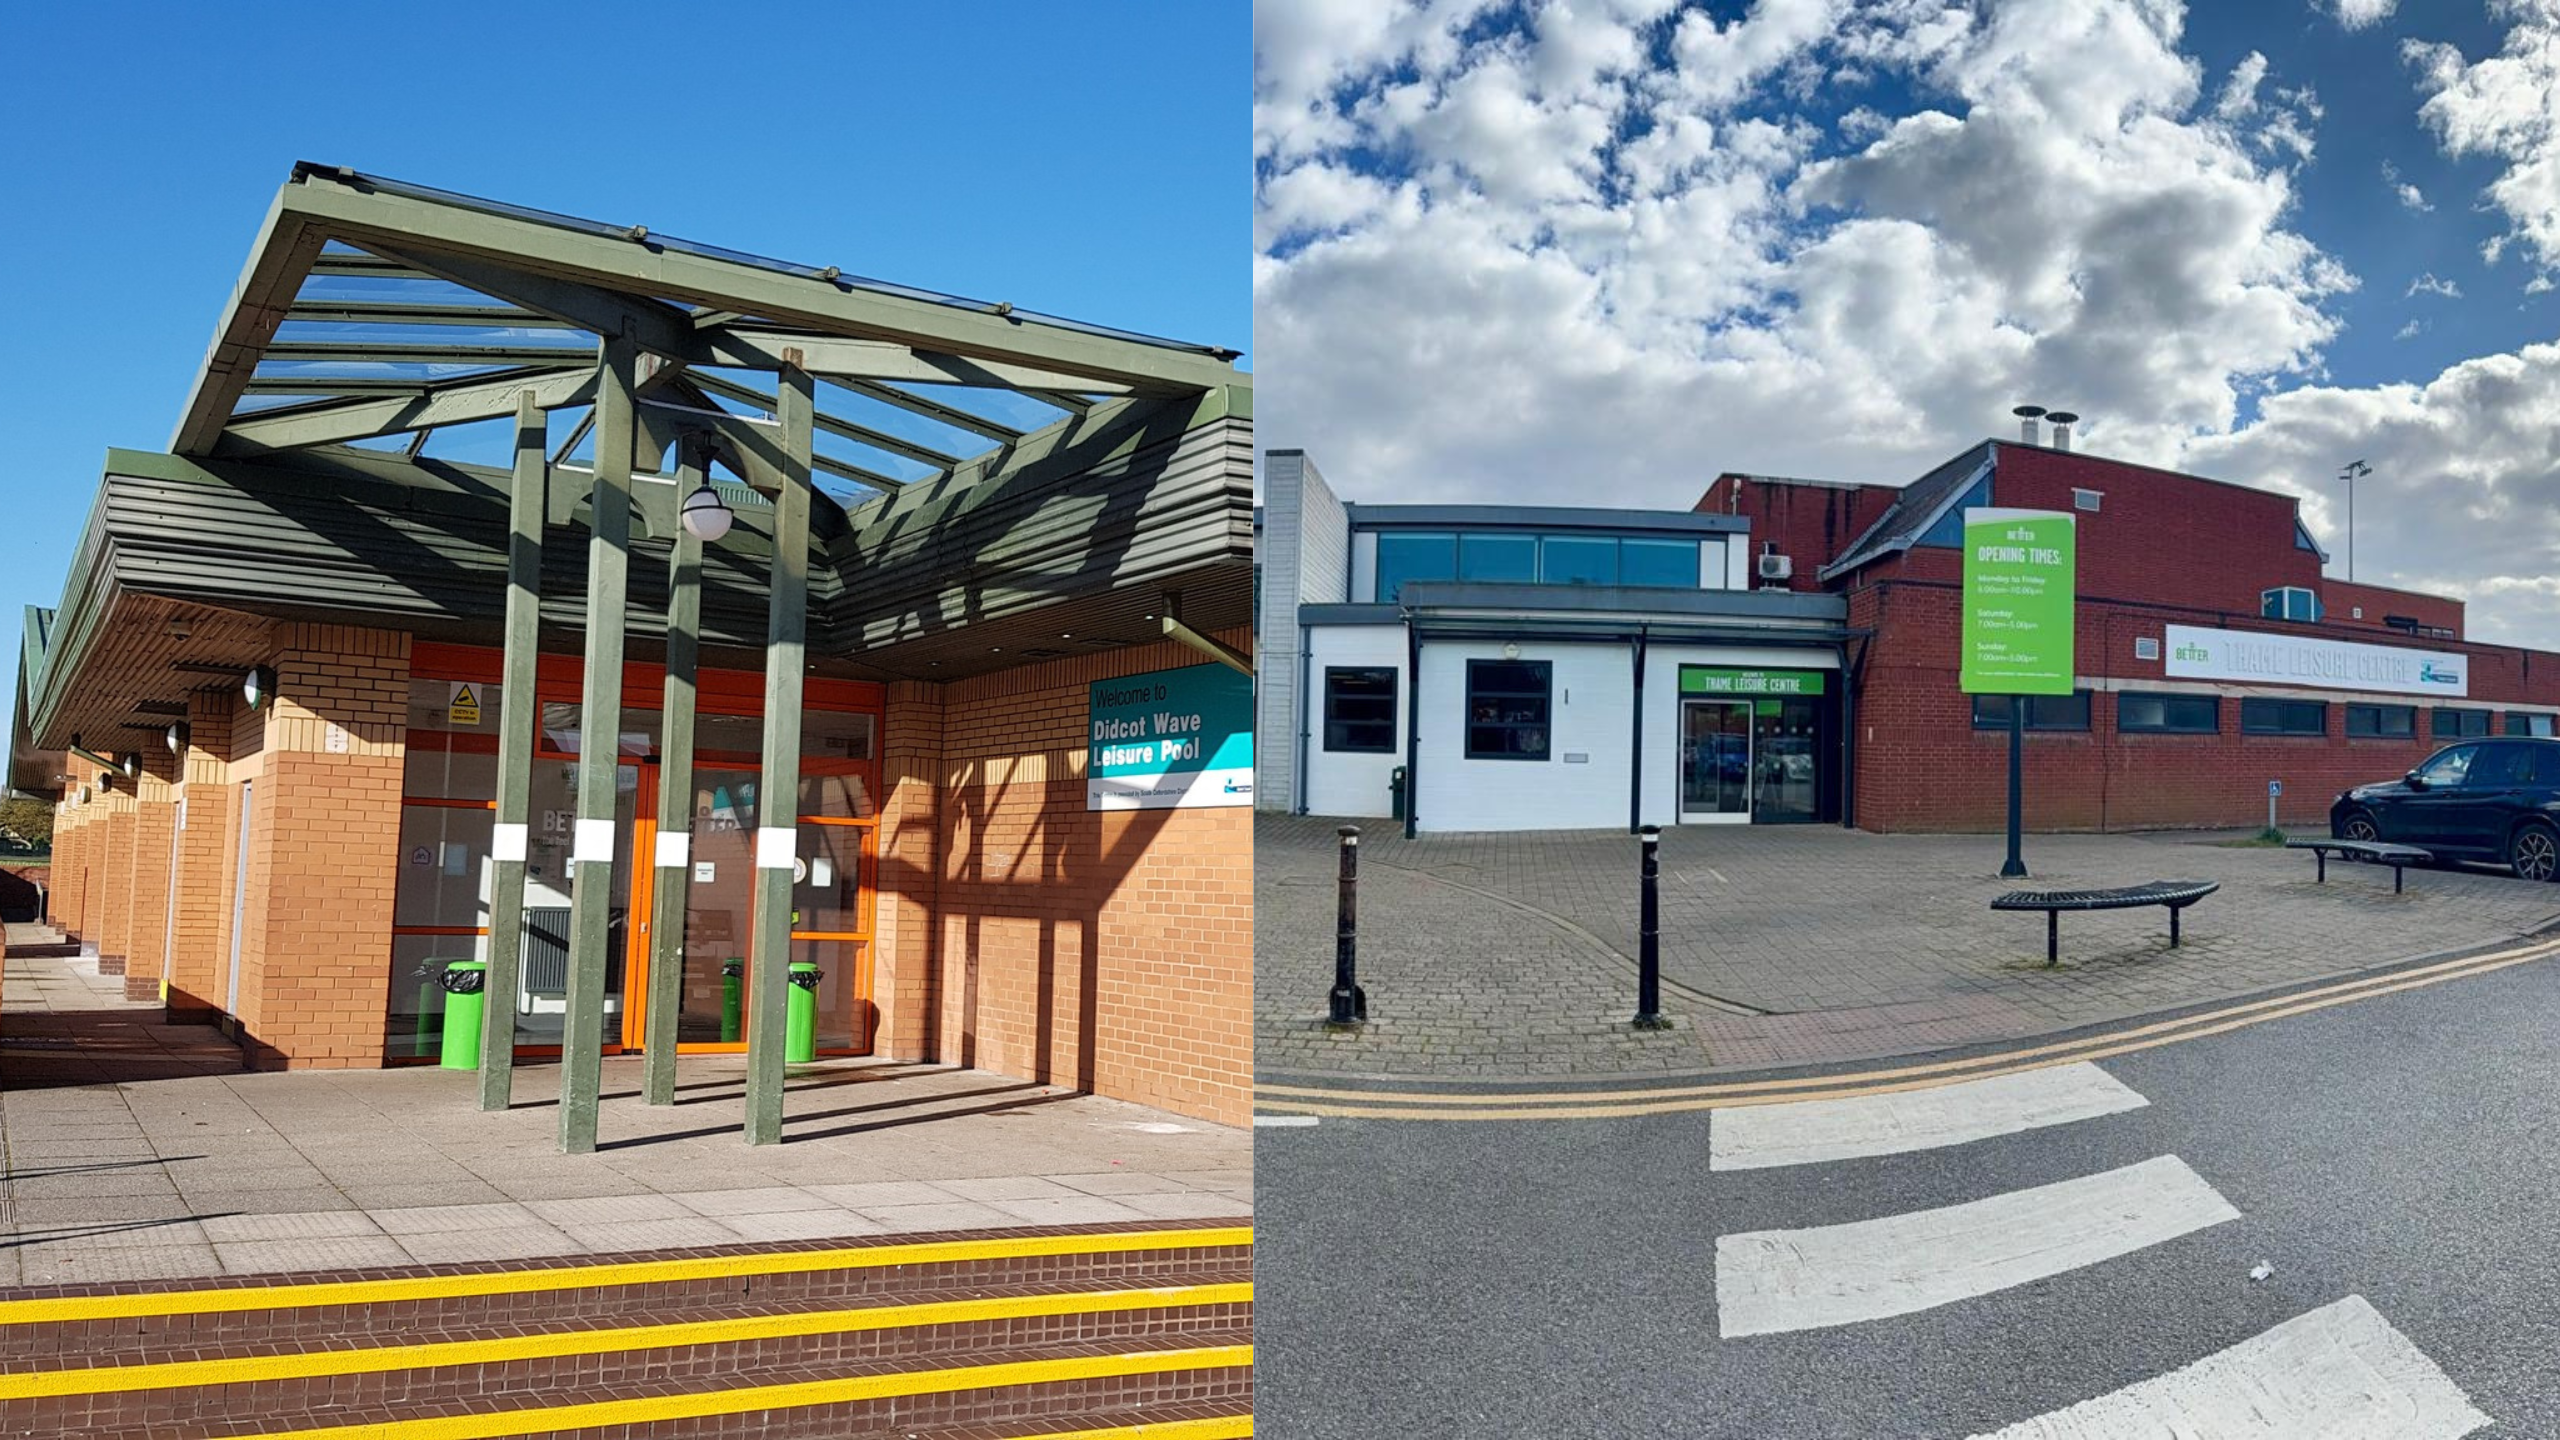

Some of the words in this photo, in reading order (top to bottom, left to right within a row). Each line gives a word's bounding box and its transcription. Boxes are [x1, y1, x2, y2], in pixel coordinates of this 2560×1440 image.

[1978, 546, 2025, 563] OPENING
[2029, 547, 2063, 565] TIMES:
[1978, 575, 2010, 585] Monday
[2175, 643, 2210, 662] BETTER
[2221, 640, 2283, 674] THAME
[2290, 647, 2353, 680] LEISURE
[2358, 652, 2411, 684] CENTRE
[1095, 686, 1151, 709] Welcome
[1154, 682, 1167, 701] to
[1705, 676, 1732, 691] THAME
[1735, 678, 1768, 692] LEISURE
[1770, 678, 1801, 692] CENTRE
[1094, 716, 1146, 740] Didcot
[1153, 712, 1201, 734] Wave
[1093, 744, 1154, 767] Leisure
[1160, 737, 1200, 762] Pool
[543, 809, 577, 832] BET
